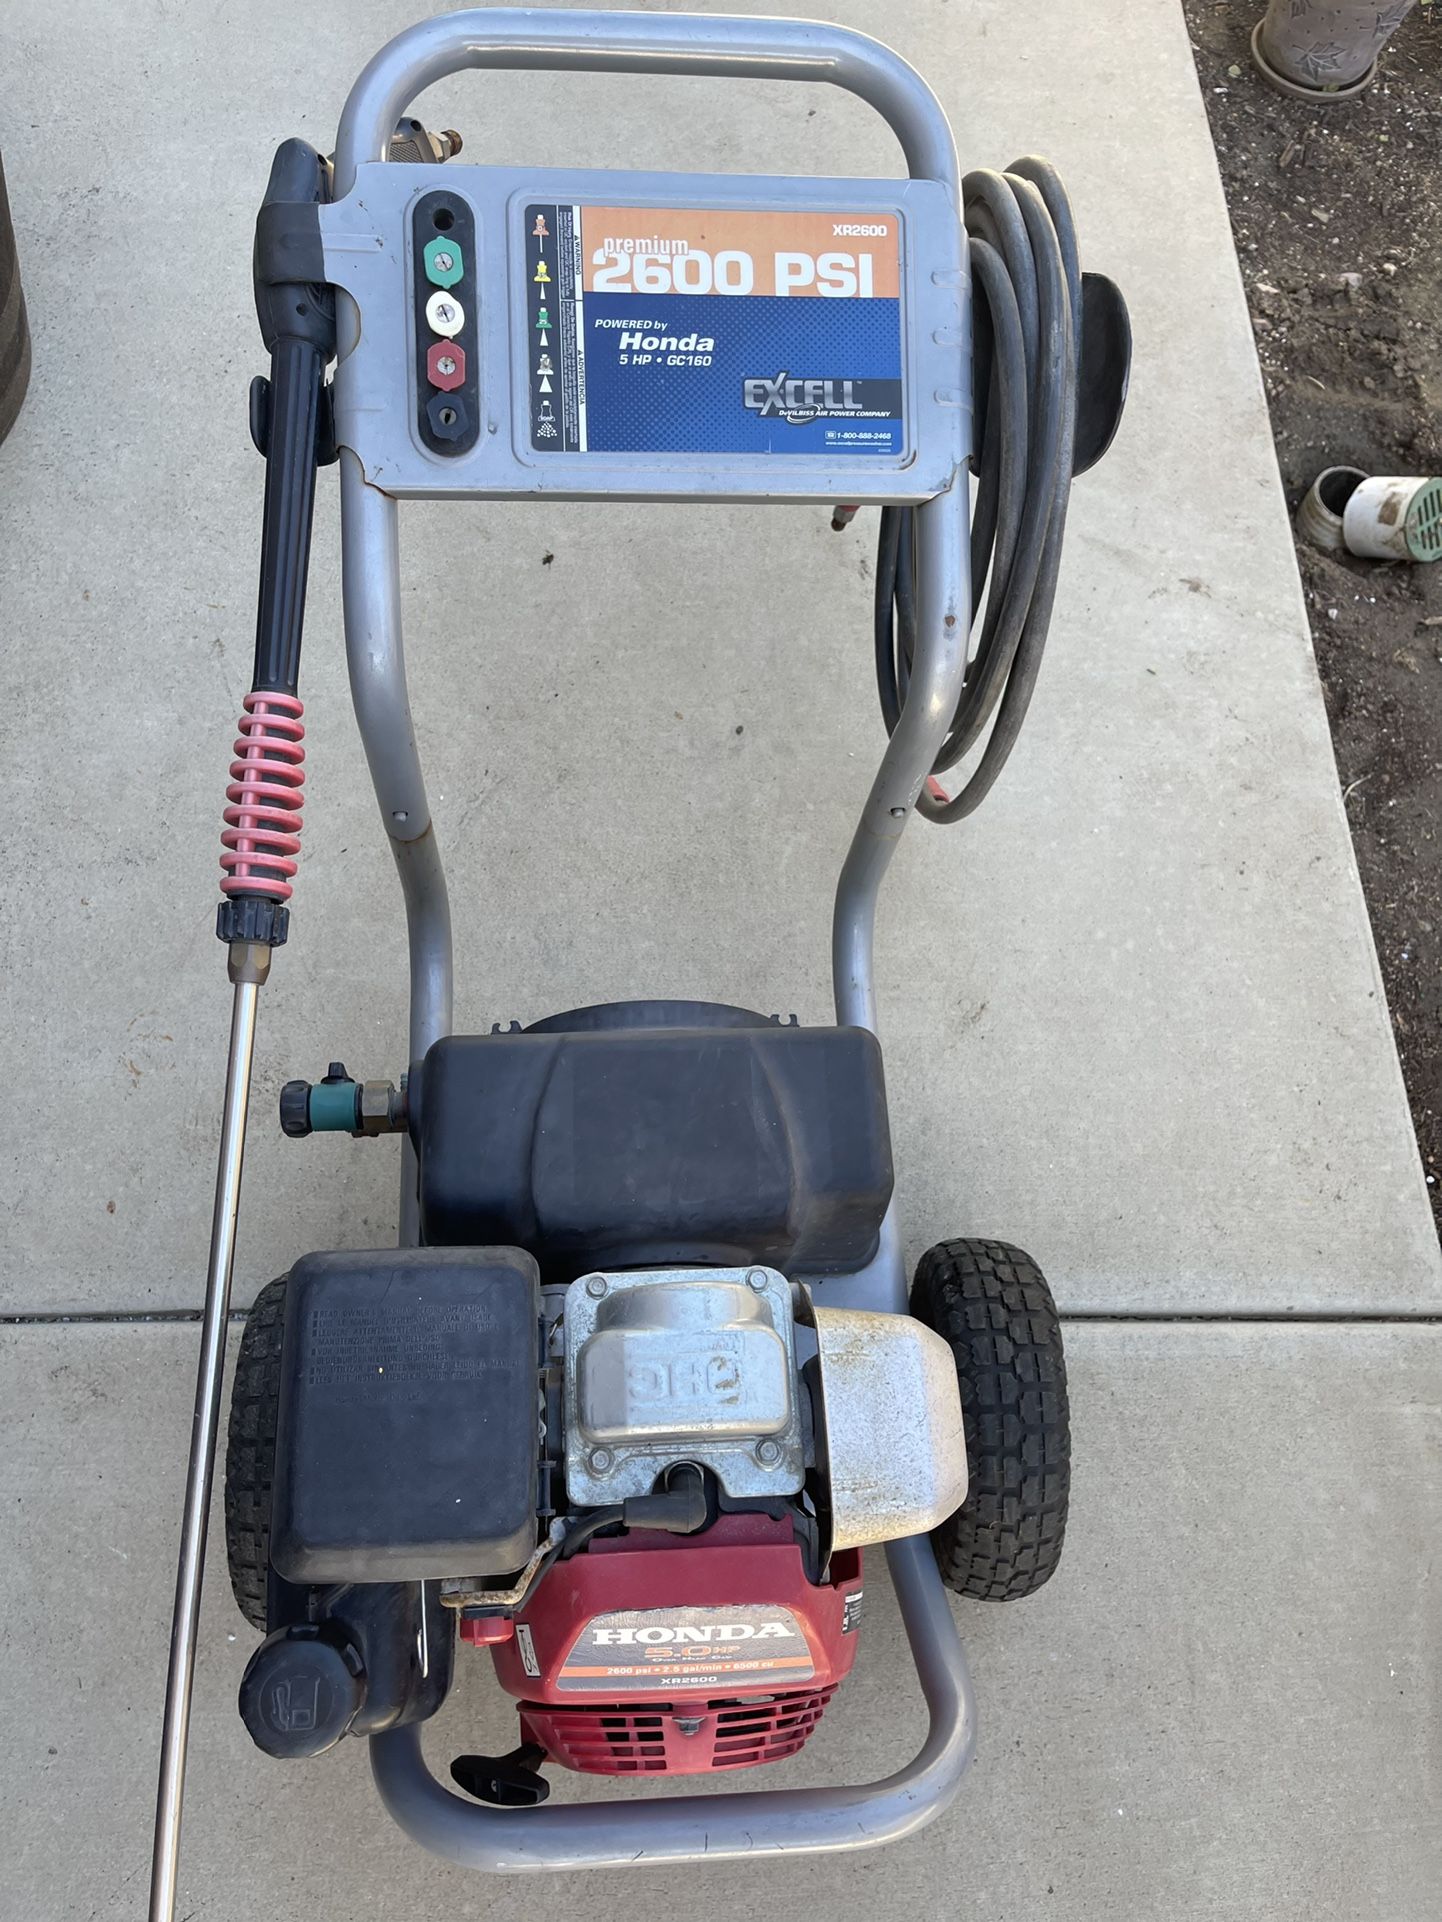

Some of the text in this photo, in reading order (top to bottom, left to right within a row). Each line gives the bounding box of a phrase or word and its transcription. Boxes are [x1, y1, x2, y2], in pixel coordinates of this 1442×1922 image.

[832, 223, 888, 237] XR2600
[603, 235, 689, 257] premium
[592, 248, 754, 296] 2600
[774, 252, 874, 299] PSI
[594, 318, 668, 331] POWERED by
[618, 331, 715, 352] Honda
[619, 353, 713, 366] 5 HP GC160
[744, 372, 863, 416] EXCELL
[592, 1621, 795, 1646] HONDA
[644, 1645, 712, 1659] 5.0
[607, 1667, 633, 1675] 2600
[635, 1666, 652, 1676] psi
[683, 1663, 723, 1674] gal/min
[660, 1675, 718, 1685] XR2600
